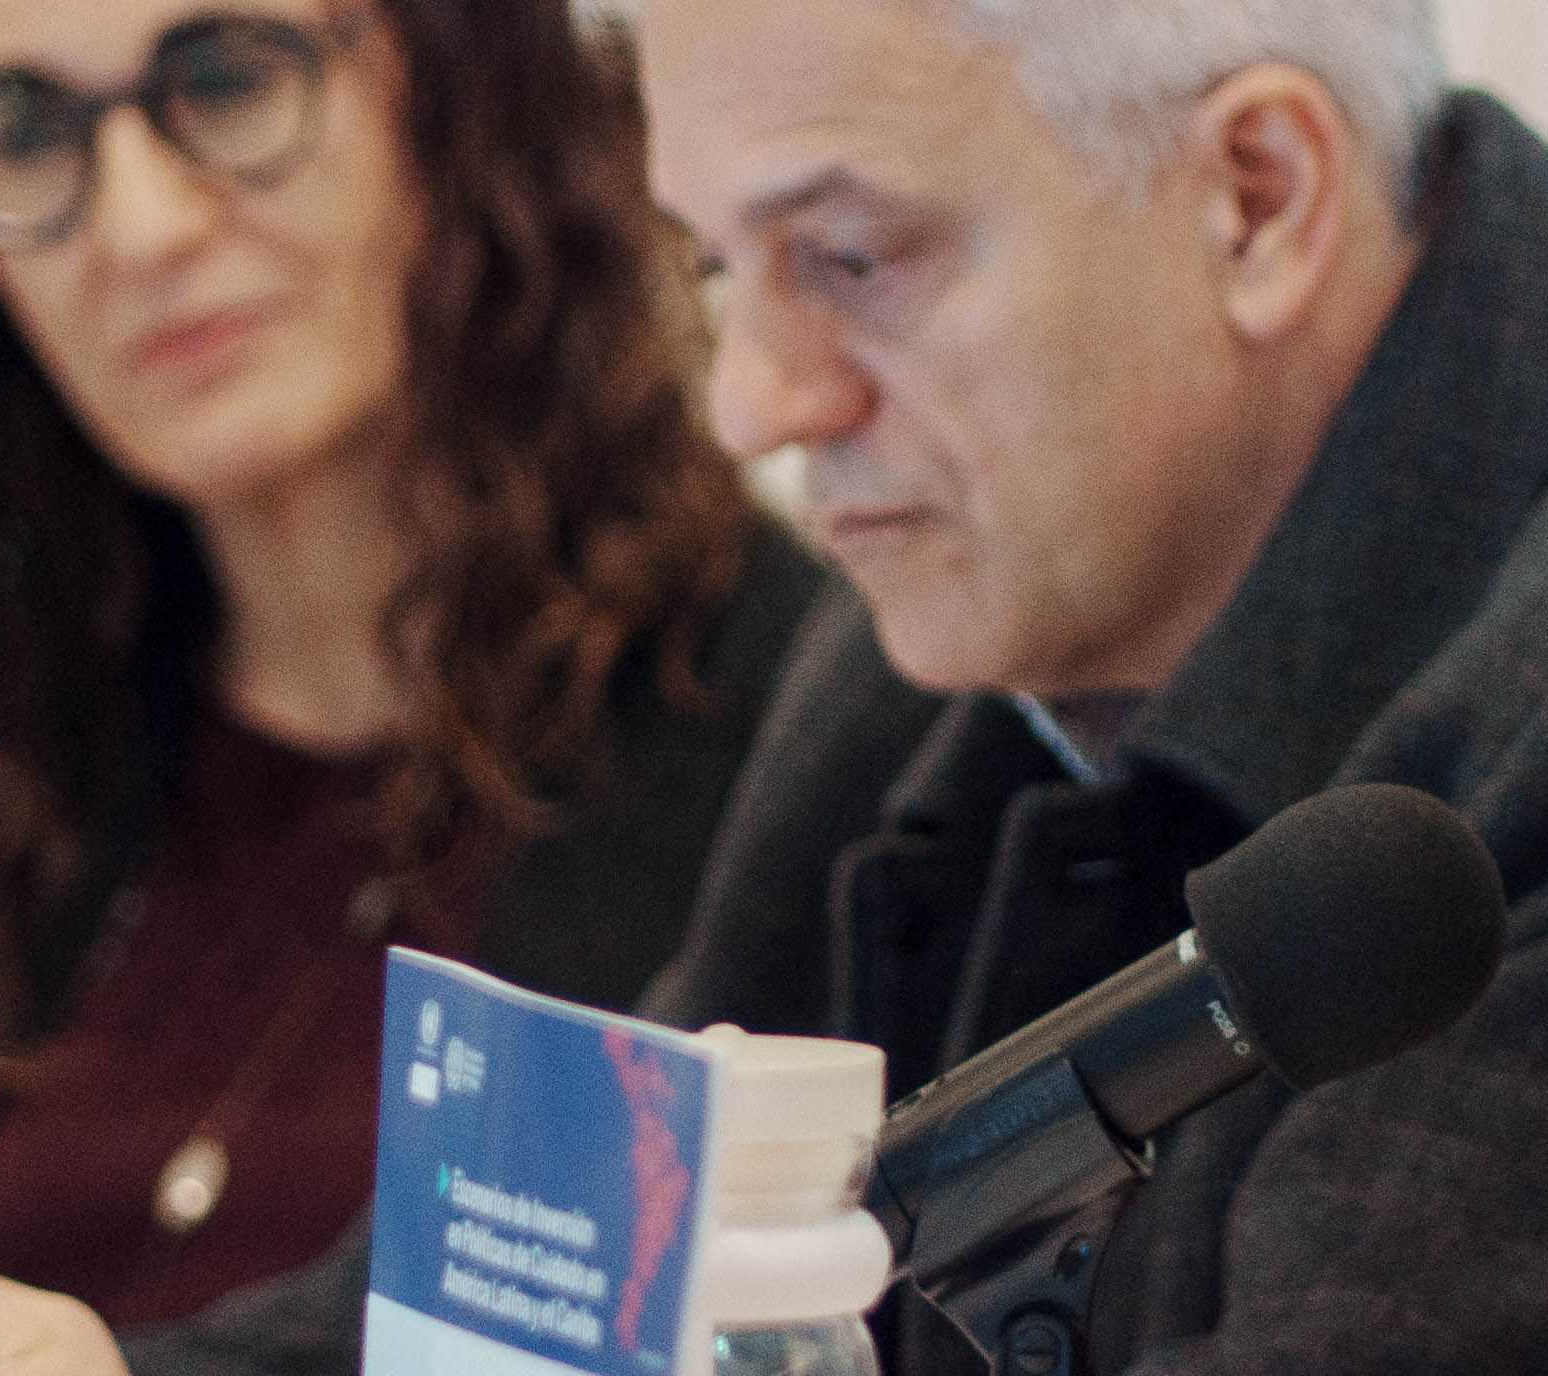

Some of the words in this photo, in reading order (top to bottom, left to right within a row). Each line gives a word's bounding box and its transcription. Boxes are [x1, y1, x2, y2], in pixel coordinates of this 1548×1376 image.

[514, 1195, 530, 1226] de
[491, 1280, 530, 1320] Latina
[556, 1298, 597, 1343] Caribe
